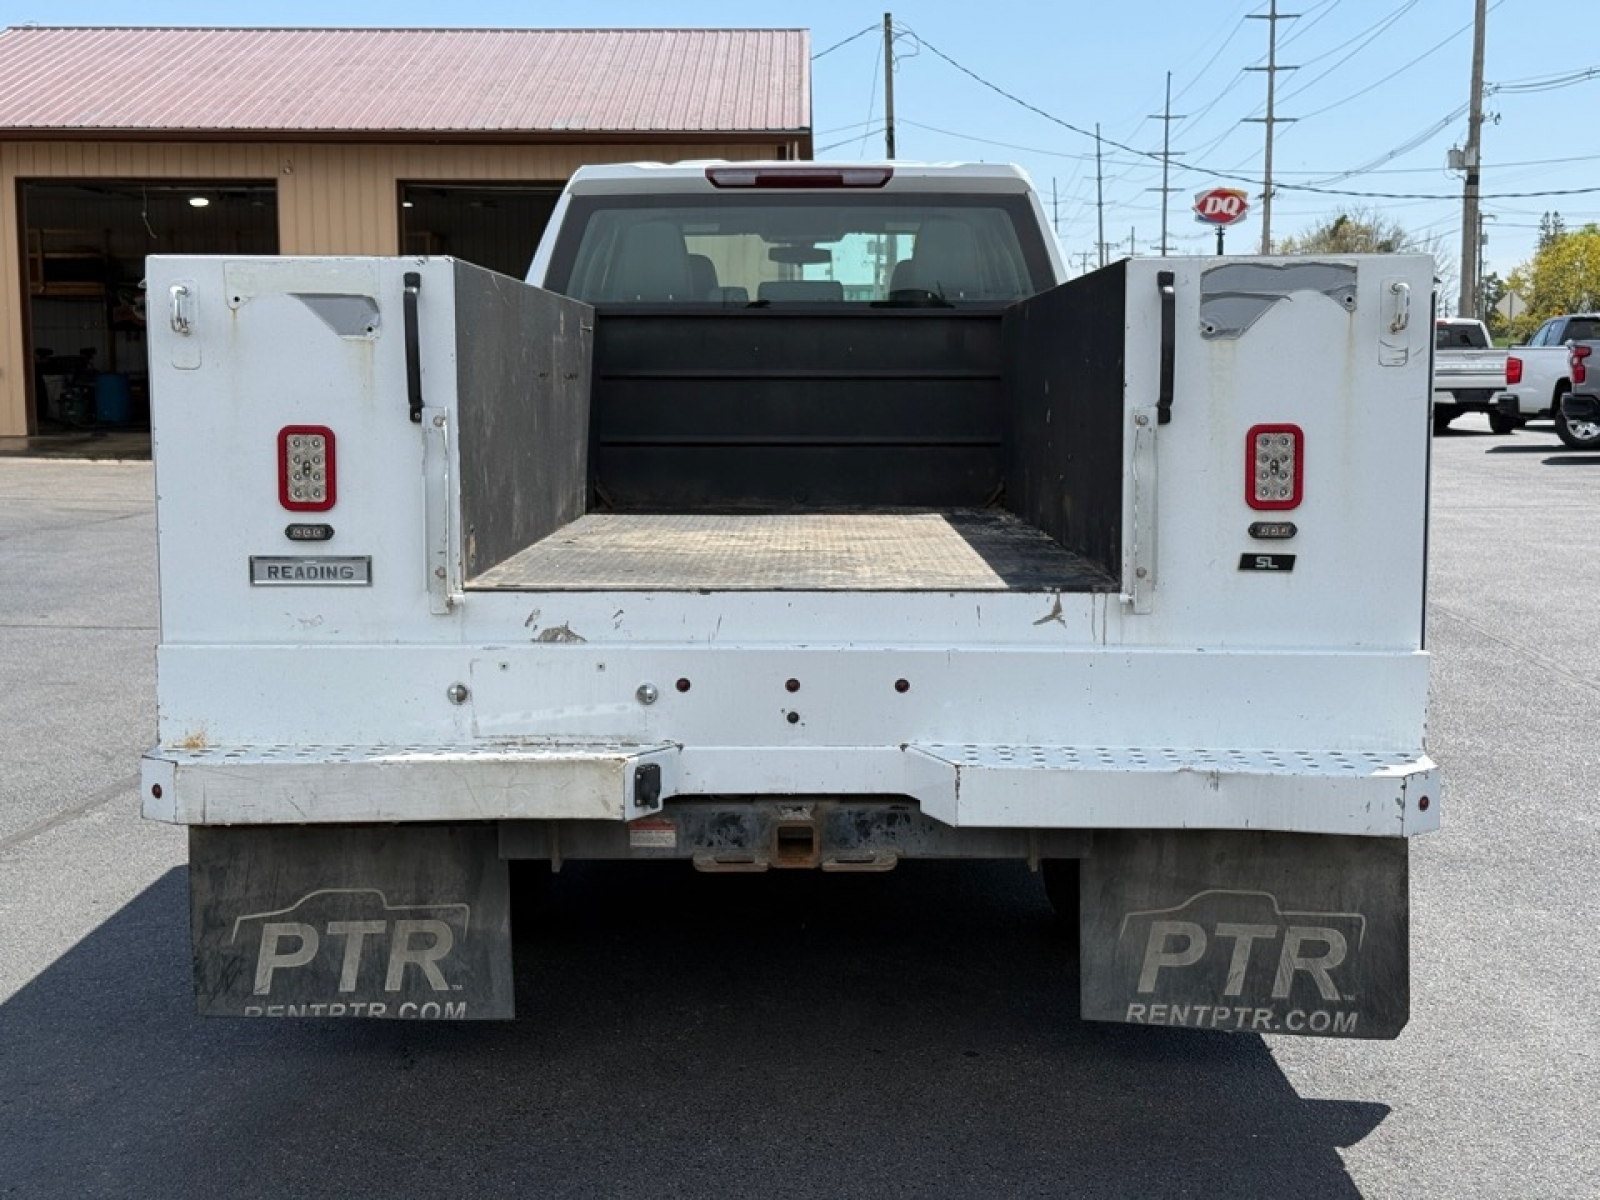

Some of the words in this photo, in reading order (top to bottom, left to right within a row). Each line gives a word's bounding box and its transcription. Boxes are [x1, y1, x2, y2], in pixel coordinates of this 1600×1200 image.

[1205, 197, 1239, 215] DQ
[267, 565, 355, 579] READING
[1255, 556, 1279, 569] SL
[253, 919, 454, 996] PTR
[1137, 920, 1348, 1001] PTR
[1125, 1002, 1358, 1033] RENTPTR.COM
